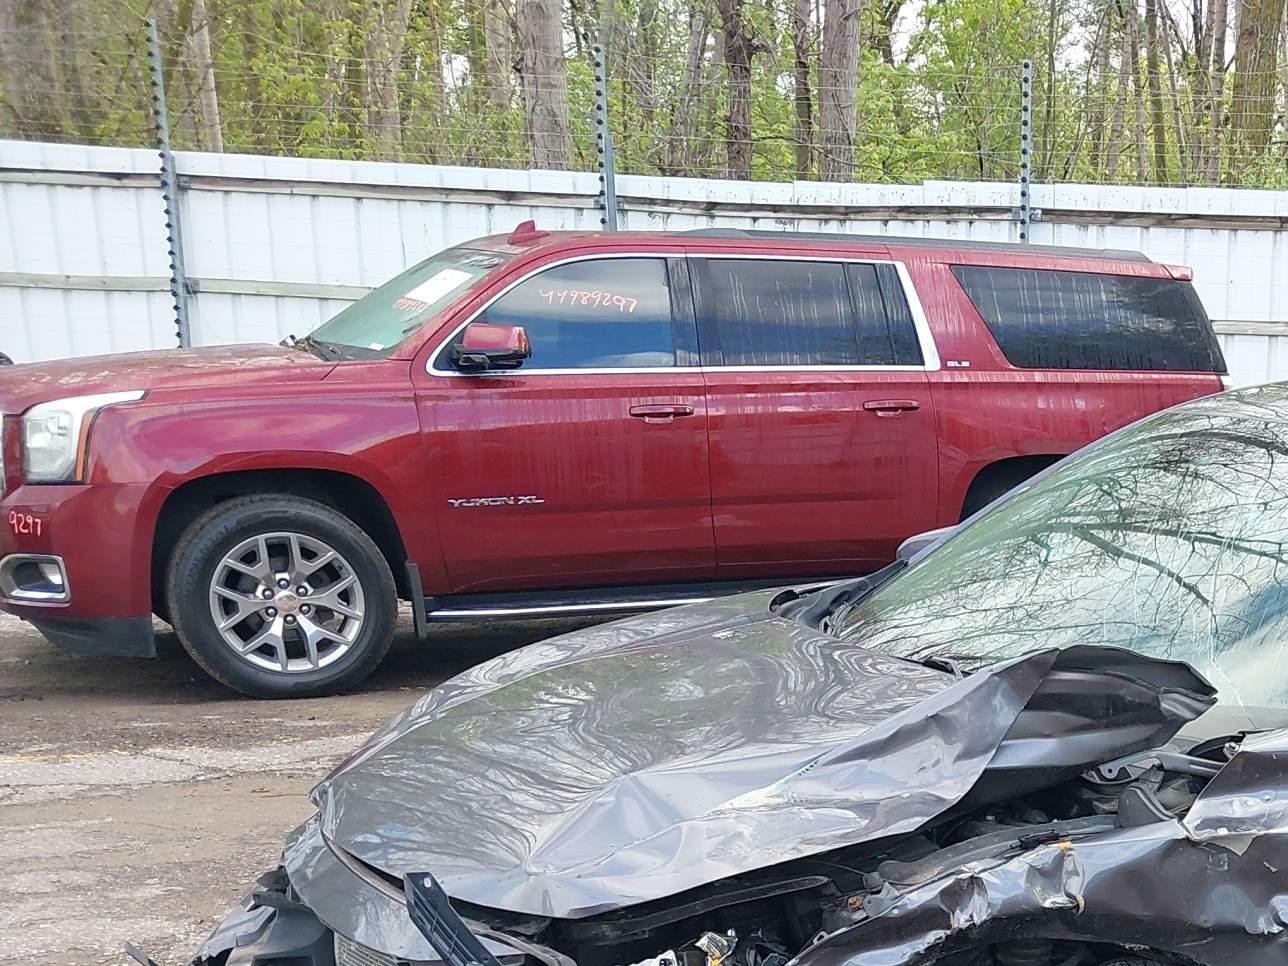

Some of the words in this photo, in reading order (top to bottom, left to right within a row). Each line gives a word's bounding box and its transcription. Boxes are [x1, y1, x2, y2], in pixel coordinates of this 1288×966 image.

[538, 288, 640, 313] 44989297
[447, 496, 515, 507] YUKON
[517, 495, 545, 505] XL
[9, 511, 41, 536] 9297
